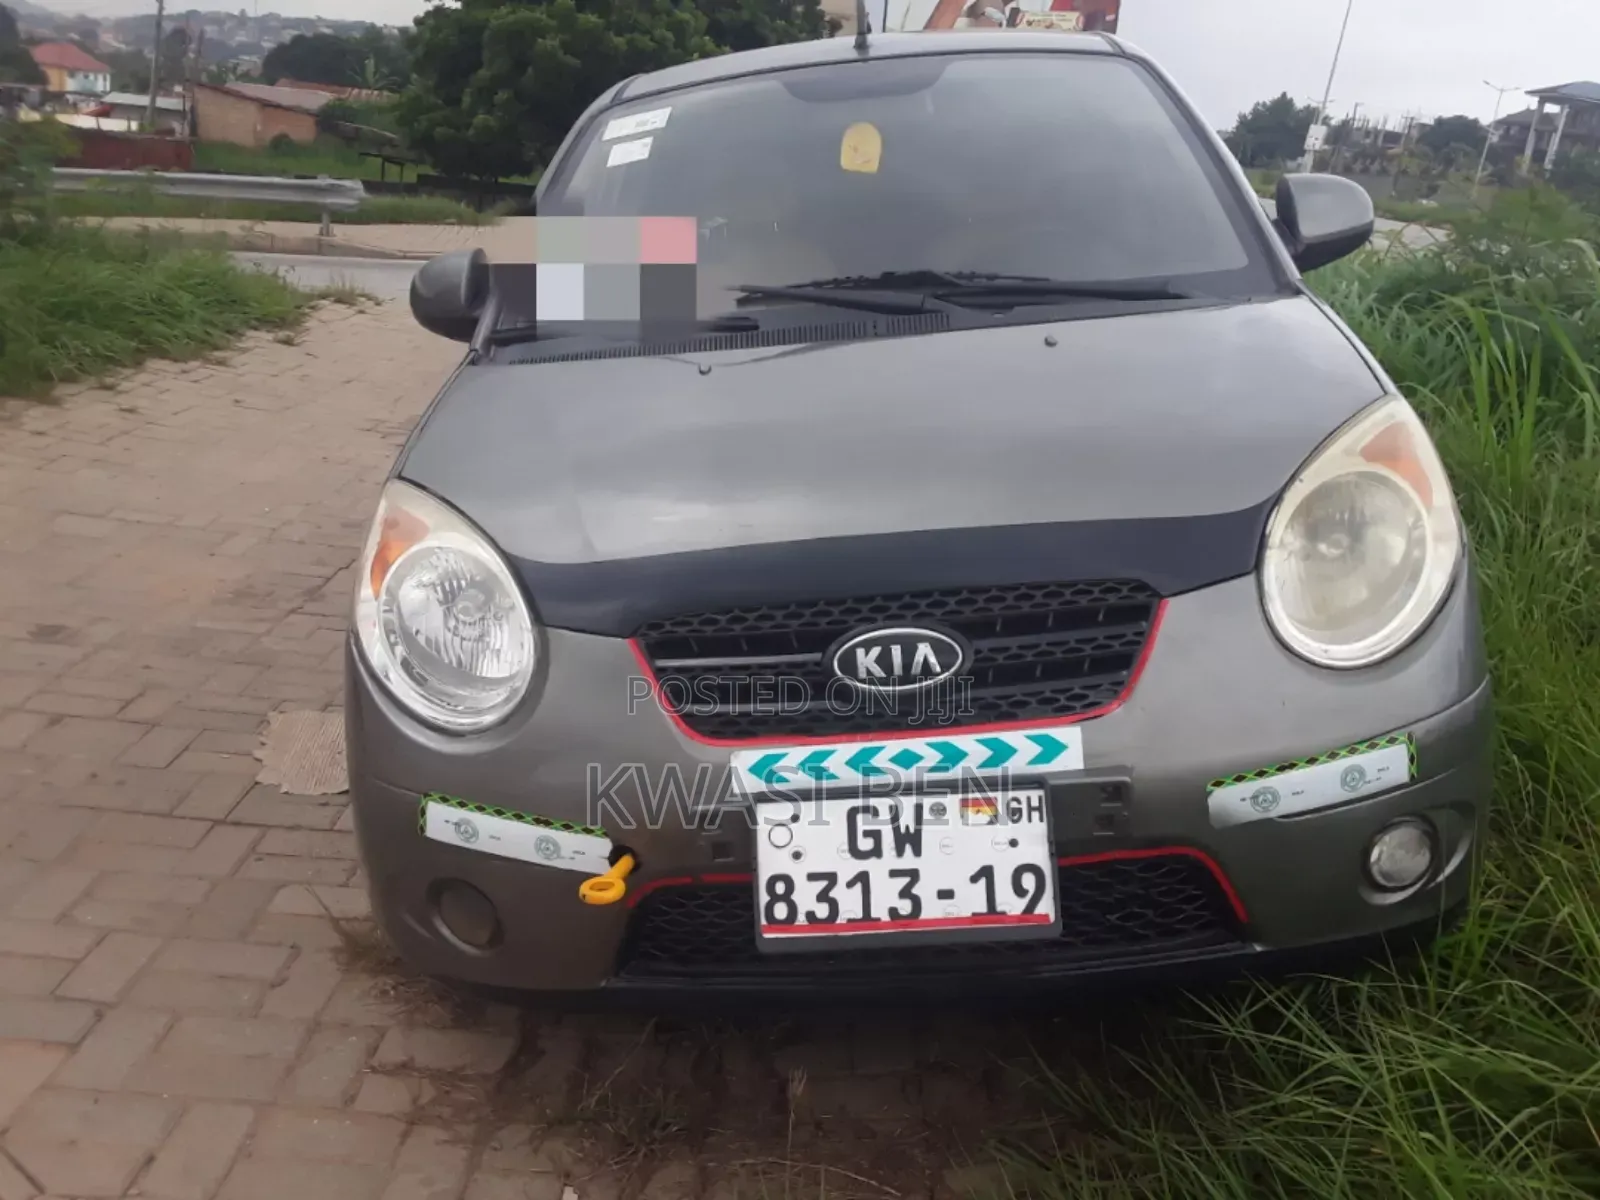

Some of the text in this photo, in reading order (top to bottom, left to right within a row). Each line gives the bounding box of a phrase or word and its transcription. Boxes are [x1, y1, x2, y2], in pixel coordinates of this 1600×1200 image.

[855, 642, 942, 679] KIA
[846, 802, 924, 860] GW
[1006, 794, 1045, 824] GH
[763, 863, 1047, 926] 8313-19
